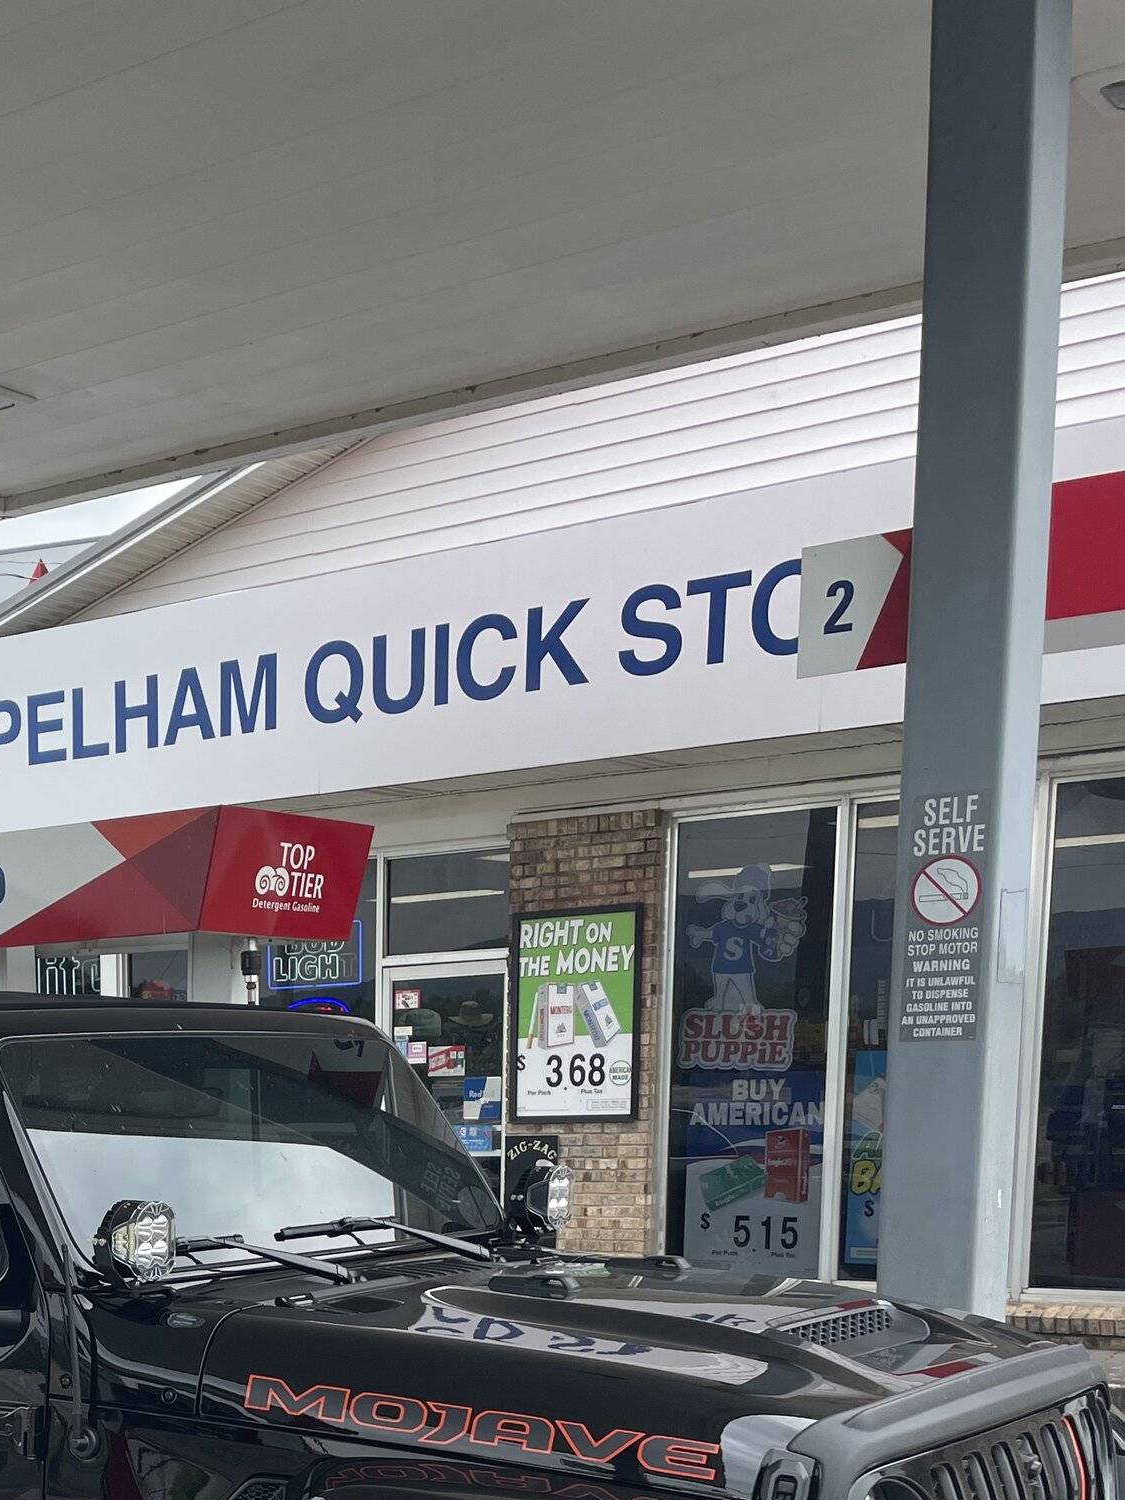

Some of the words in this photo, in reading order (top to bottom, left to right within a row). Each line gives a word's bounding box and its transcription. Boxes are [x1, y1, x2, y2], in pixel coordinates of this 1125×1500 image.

[822, 579, 855, 636] 2
[304, 597, 590, 725] QUICK
[924, 794, 979, 827] SELF
[913, 823, 986, 857] SERVE
[280, 841, 316, 870] TOP
[290, 871, 325, 899] TIER
[252, 897, 291, 912] Detergent
[292, 901, 320, 913] Gasoline
[519, 919, 585, 948] RIGHT
[586, 921, 613, 944] ON
[908, 929, 925, 942] NO
[927, 926, 979, 941] SMOKING
[907, 943, 936, 957] STOP
[938, 941, 978, 955] MOTOR
[273, 952, 356, 982] LIGHT
[519, 955, 550, 978] THE
[556, 944, 635, 976] MONEY
[912, 958, 971, 973] WARNING
[905, 978, 915, 988] IT
[917, 977, 926, 987] IS
[928, 975, 976, 987] UNLAWFUL
[911, 990, 924, 1000] TO
[925, 988, 969, 999] DISPENSE
[906, 1002, 949, 1013] GASOLINE
[951, 1001, 973, 1011] INTO
[683, 1014, 791, 1042] SLUSH
[901, 1015, 914, 1025] AN
[916, 1013, 976, 1025] UNAPPROVED
[913, 1026, 963, 1037] CONTAINER
[516, 1053, 526, 1072] $
[609, 1066, 632, 1074] AMERICA
[732, 1078, 787, 1101] BUY
[689, 1101, 825, 1126] AMERICAN
[506, 1139, 558, 1161] ZIG-ZAG
[700, 1212, 711, 1230] $
[244, 1372, 721, 1481] MOJAVE
